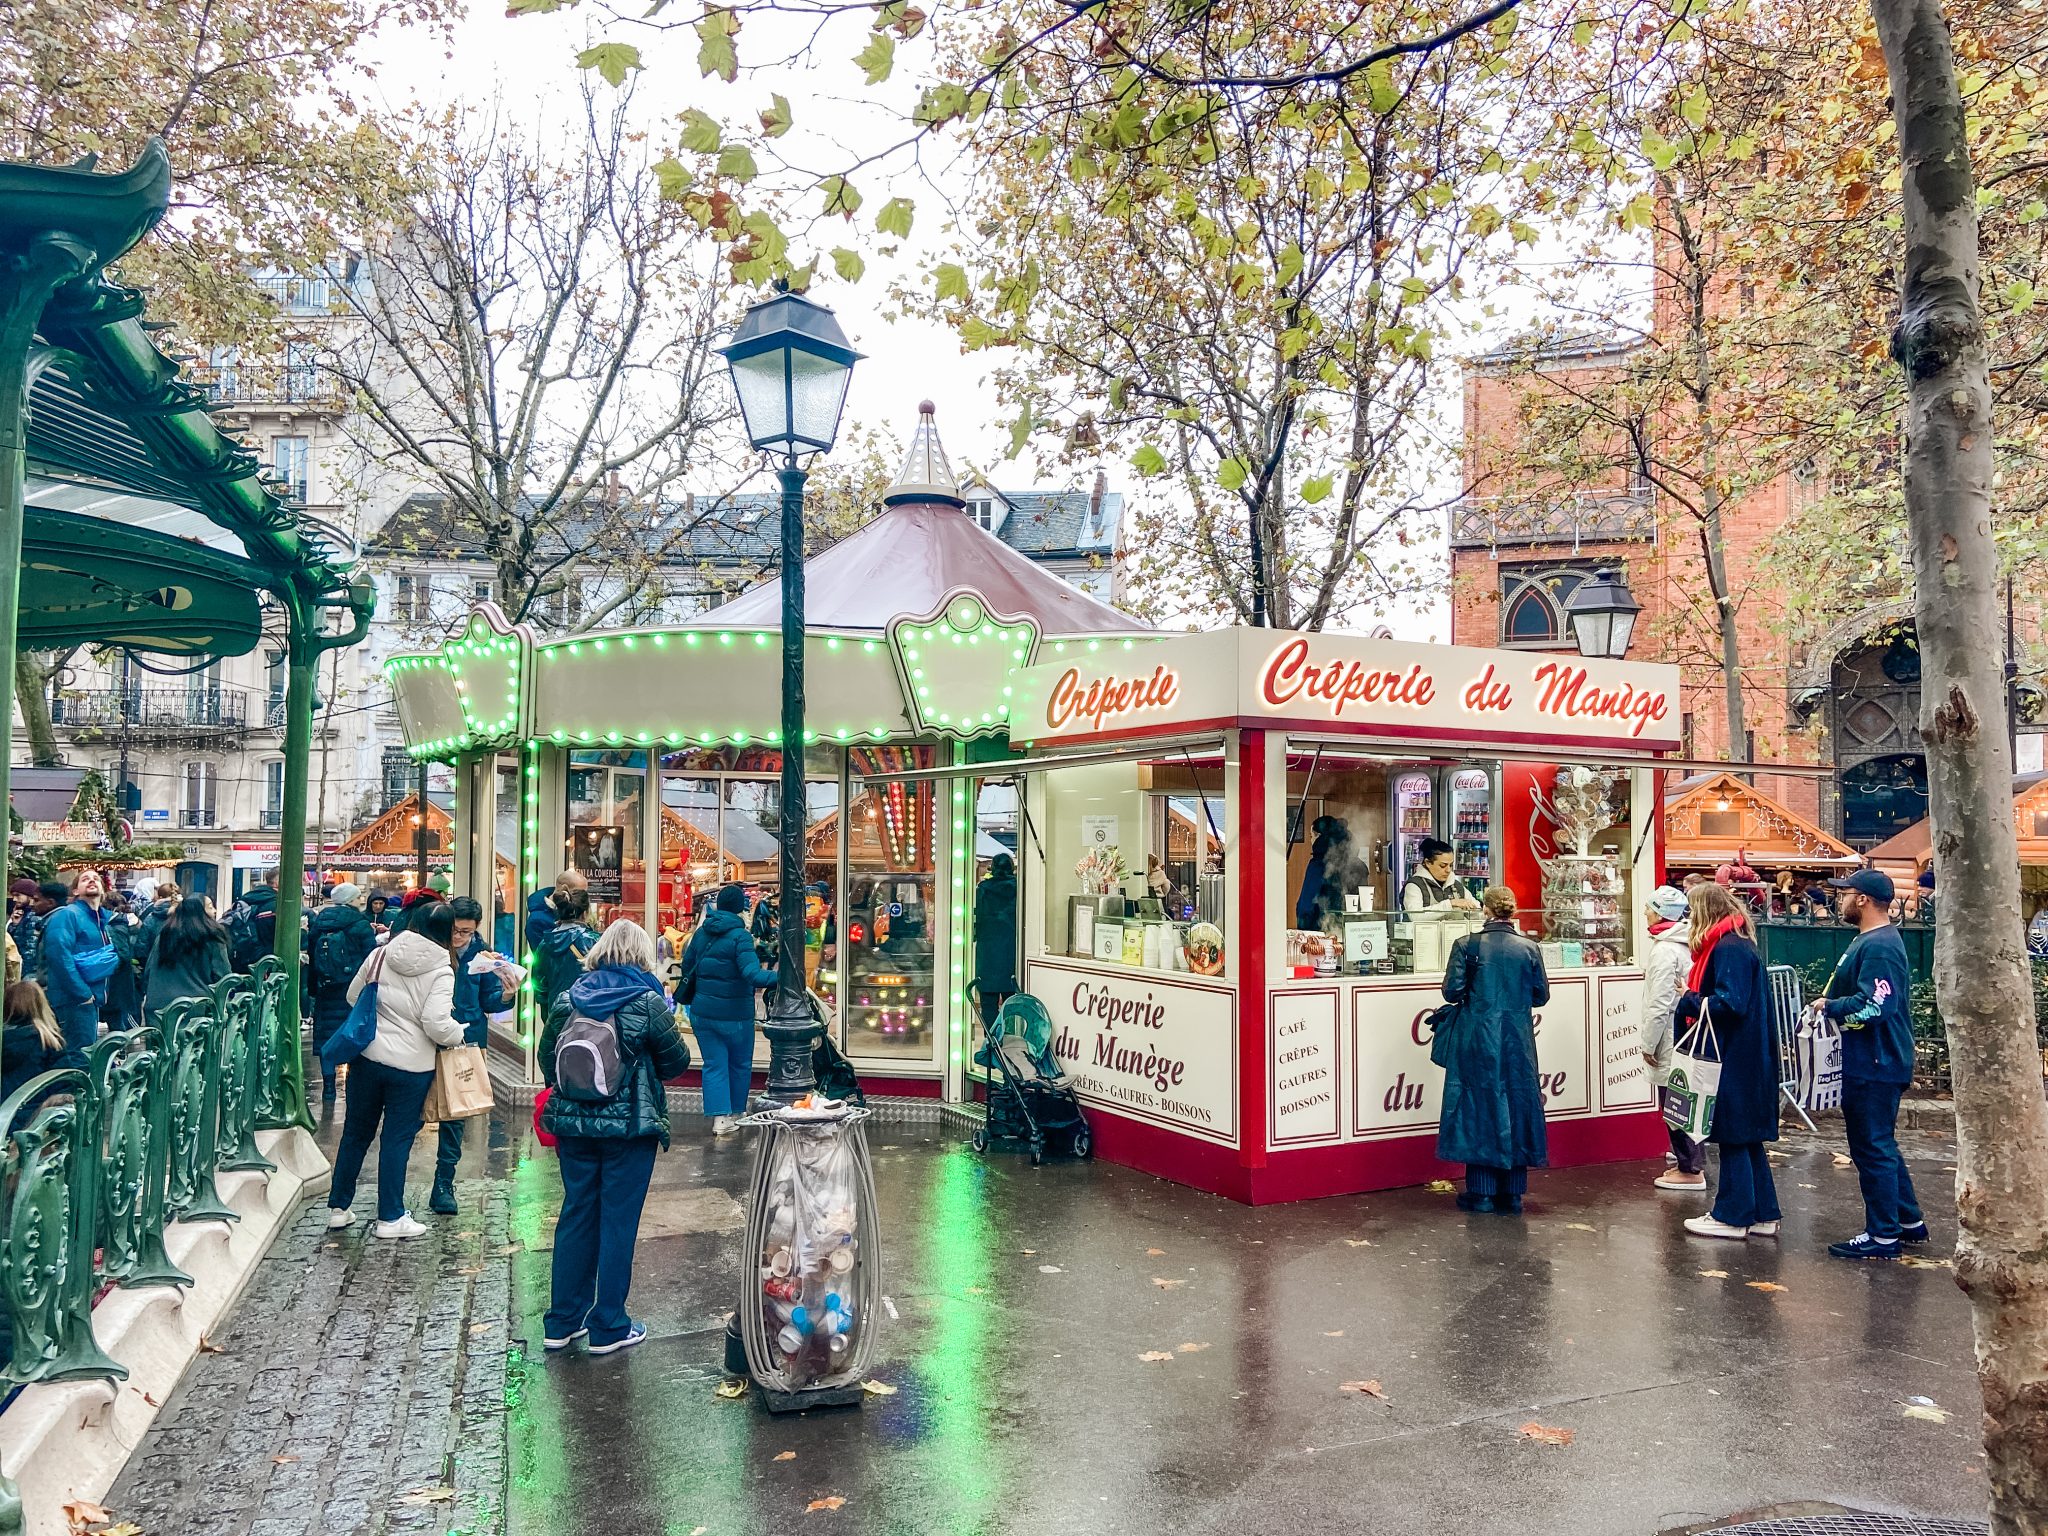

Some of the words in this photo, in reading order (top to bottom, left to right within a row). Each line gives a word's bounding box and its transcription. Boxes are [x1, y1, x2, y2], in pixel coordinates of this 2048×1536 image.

[1047, 665, 1177, 730] Crêperie
[1264, 638, 1436, 715] Crêperie
[1465, 664, 1513, 711] du
[1534, 662, 1668, 737] Manège
[586, 868, 594, 878] LA
[1072, 981, 1165, 1030] Crêperie
[1606, 1000, 1629, 1018] CAFÉ
[1279, 1018, 1307, 1037] CAFÉ
[1606, 1023, 1639, 1042] CRÊPES
[1055, 1025, 1080, 1061] du
[1091, 1033, 1185, 1093] Manège
[1278, 1044, 1319, 1065] CRÊPES
[1278, 1067, 1328, 1091] GAUFRES
[1110, 1084, 1154, 1108] GAUFRES
[1161, 1097, 1212, 1123] BOISSONS
[1279, 1091, 1331, 1116] BOISSONS
[1383, 1072, 1425, 1112] du
